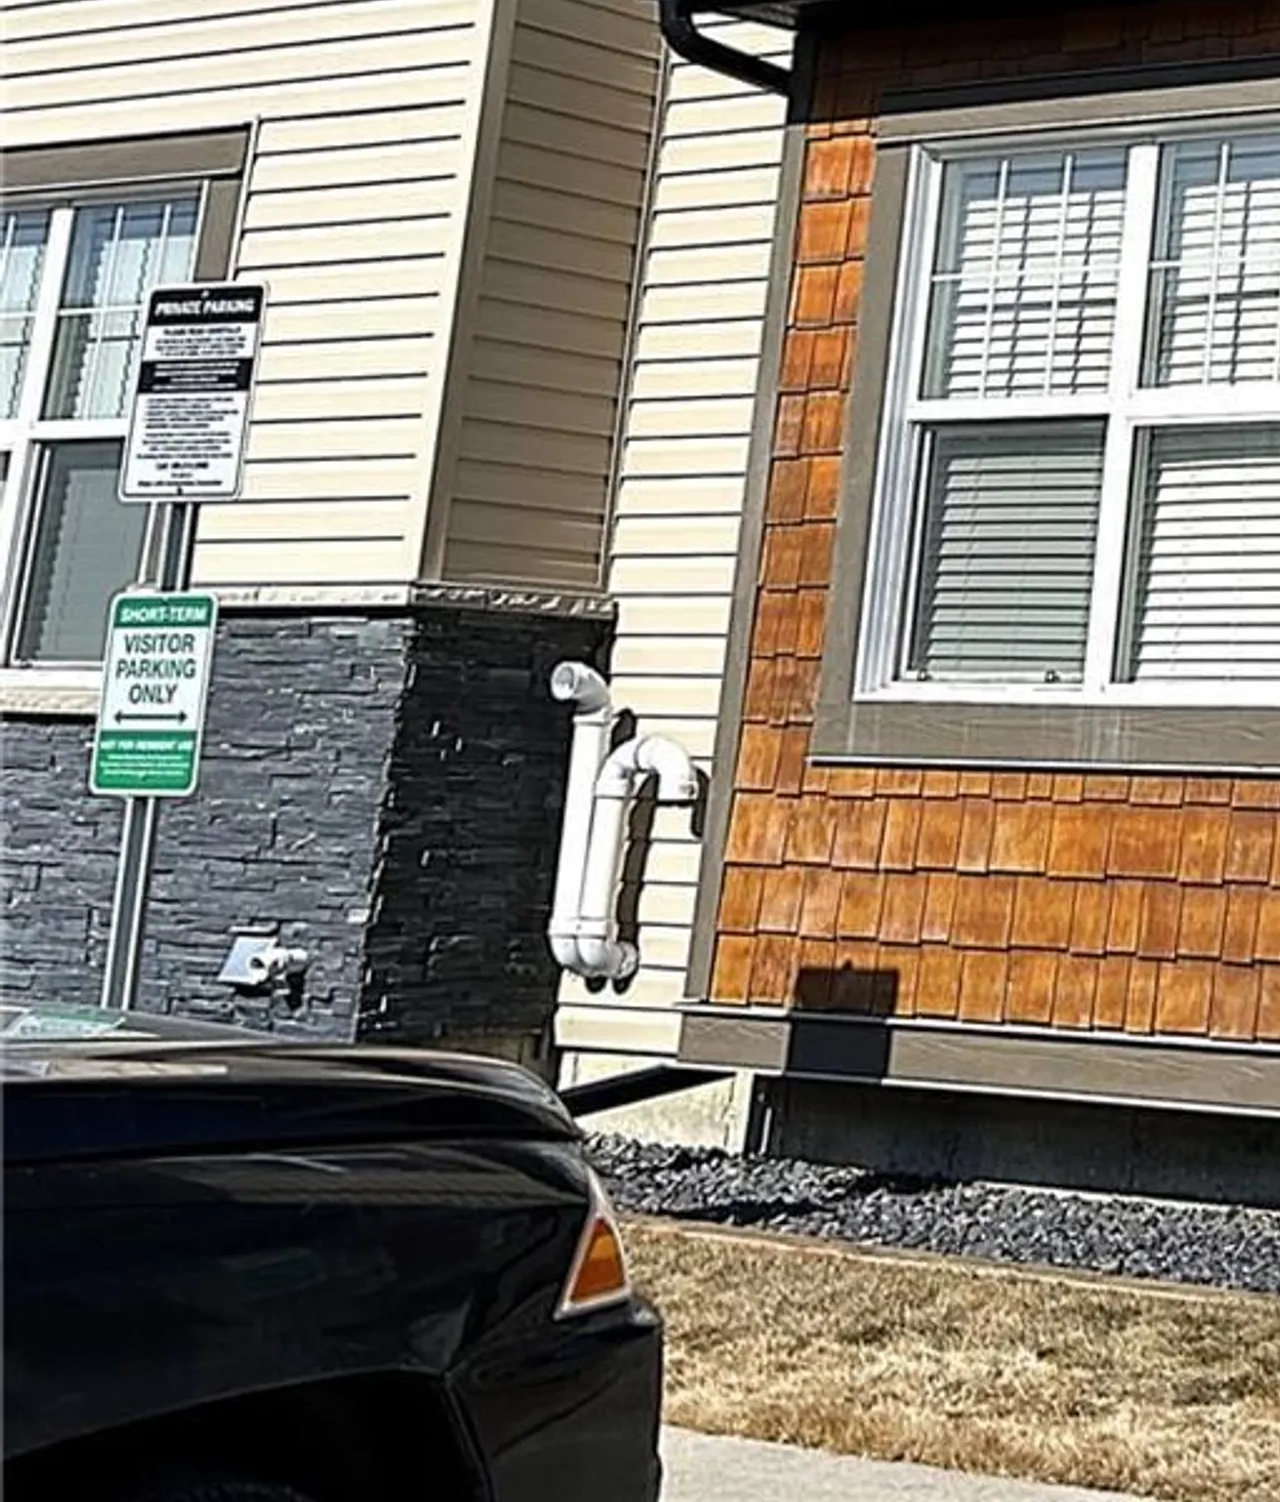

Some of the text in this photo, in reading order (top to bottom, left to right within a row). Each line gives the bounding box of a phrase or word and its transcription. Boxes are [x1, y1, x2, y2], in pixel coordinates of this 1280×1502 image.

[121, 606, 207, 623] SHORT-TERM
[124, 634, 195, 654] VISITOR
[115, 659, 196, 679] PARKING
[129, 684, 177, 705] ONLY
